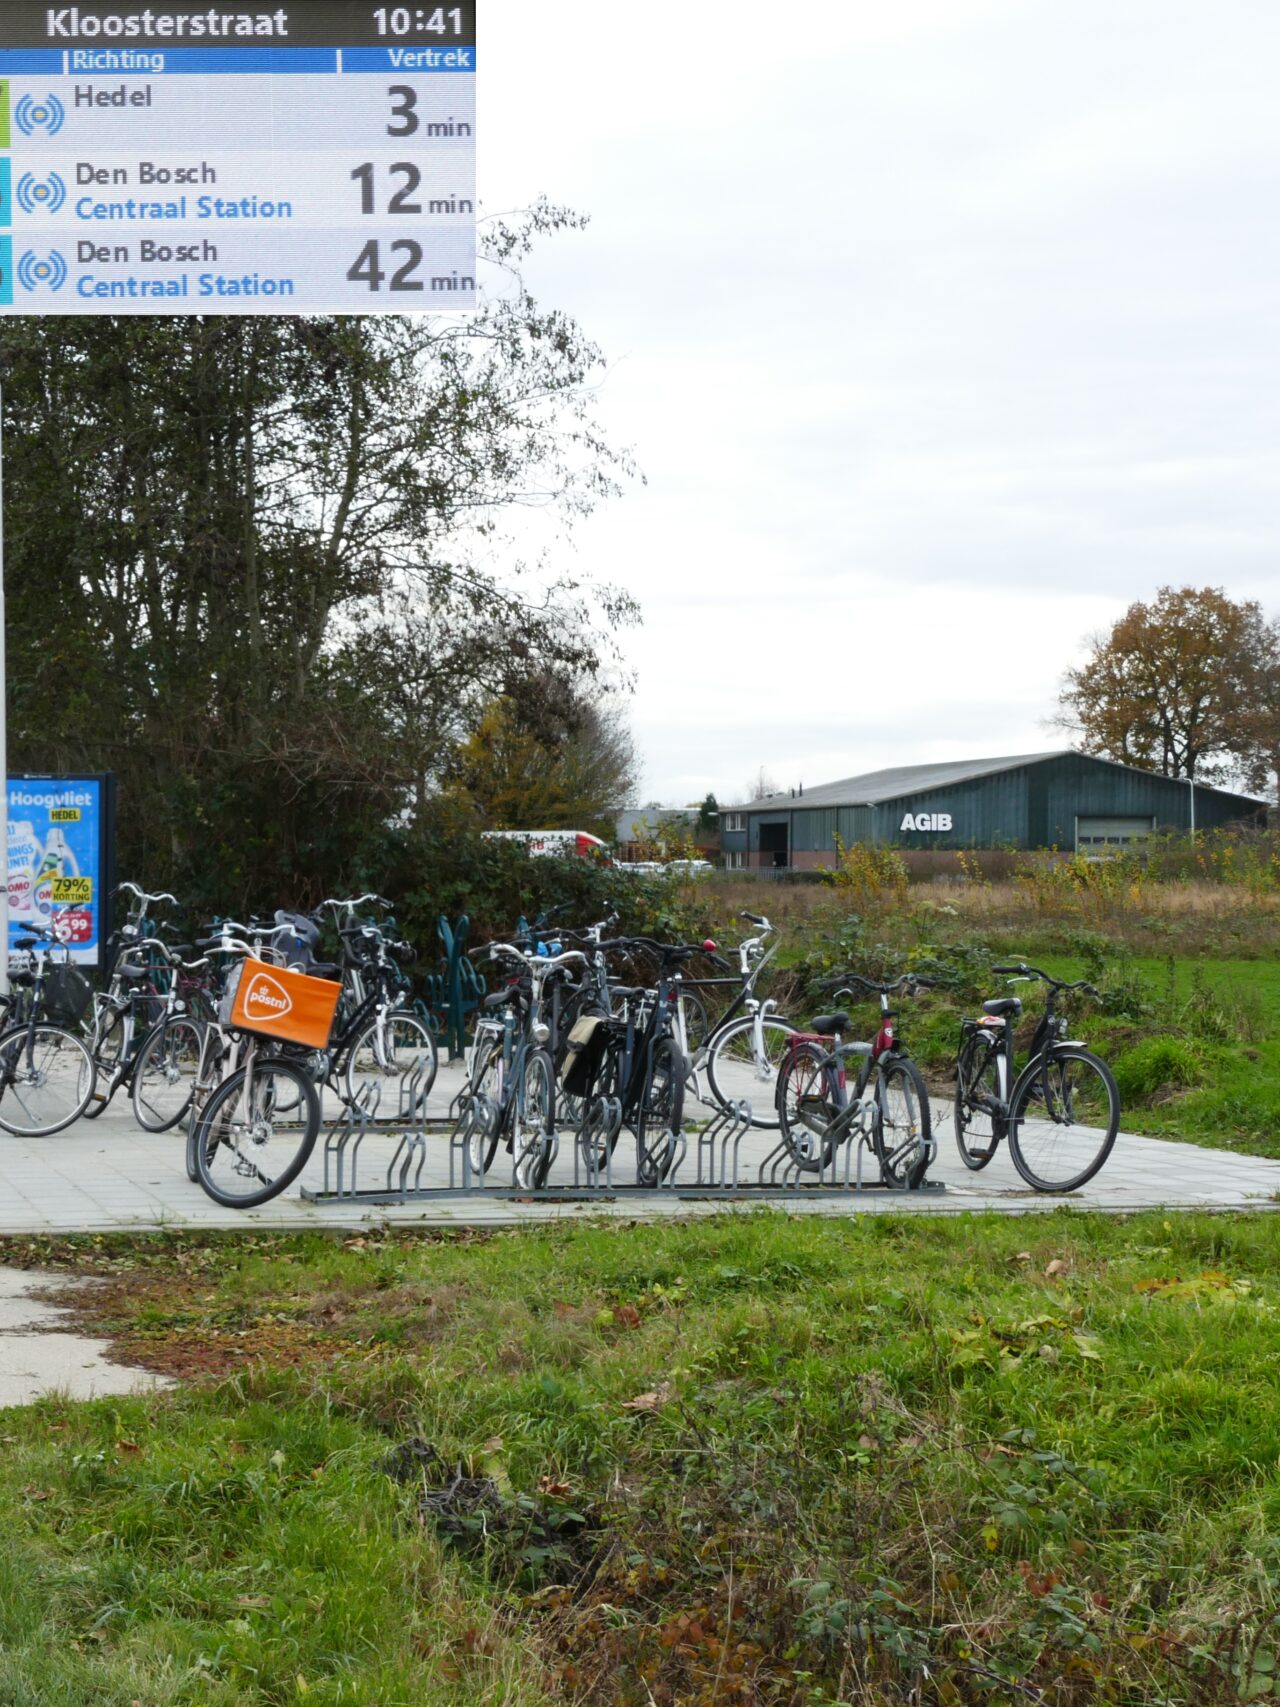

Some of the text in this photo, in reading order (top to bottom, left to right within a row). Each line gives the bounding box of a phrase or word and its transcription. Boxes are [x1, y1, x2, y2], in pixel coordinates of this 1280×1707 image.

[47, 7, 288, 36] Kloosterstraat
[374, 8, 462, 35] 10:41
[72, 49, 165, 72] Richting
[387, 48, 471, 67] Vertrek
[74, 84, 152, 107] Hedel
[387, 85, 471, 137] 3 min
[75, 162, 217, 185] Den Bosch
[350, 161, 472, 215] 12 min
[75, 195, 293, 220] Centraal Station
[77, 239, 218, 263] Den Bosch
[346, 239, 475, 291] 42 min
[77, 273, 294, 298] Centraal Station
[10, 790, 92, 808] Hoogvliet
[51, 810, 79, 820] HEDEL
[900, 813, 953, 831] AGIB
[8, 882, 30, 893] OMO
[53, 878, 89, 892] 79%
[53, 892, 90, 901] KORTING
[250, 992, 286, 1009] postnl
